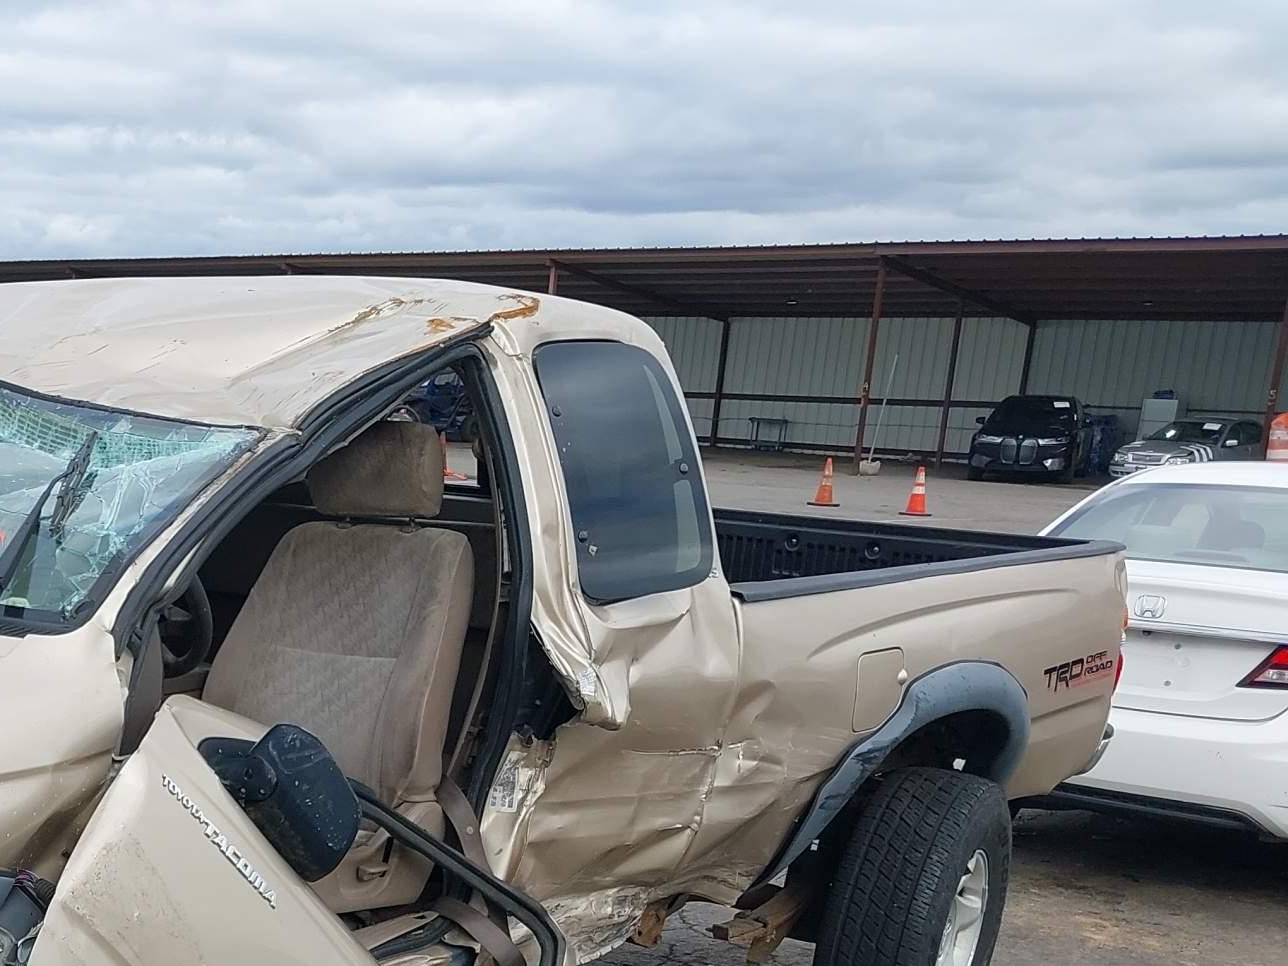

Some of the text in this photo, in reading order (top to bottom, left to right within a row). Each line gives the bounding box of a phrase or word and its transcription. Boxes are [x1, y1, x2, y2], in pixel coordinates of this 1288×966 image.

[1043, 650, 1108, 692] TRD OFF
[1084, 660, 1113, 676] ROAD
[161, 774, 278, 909] TOYOTA TACOMA
